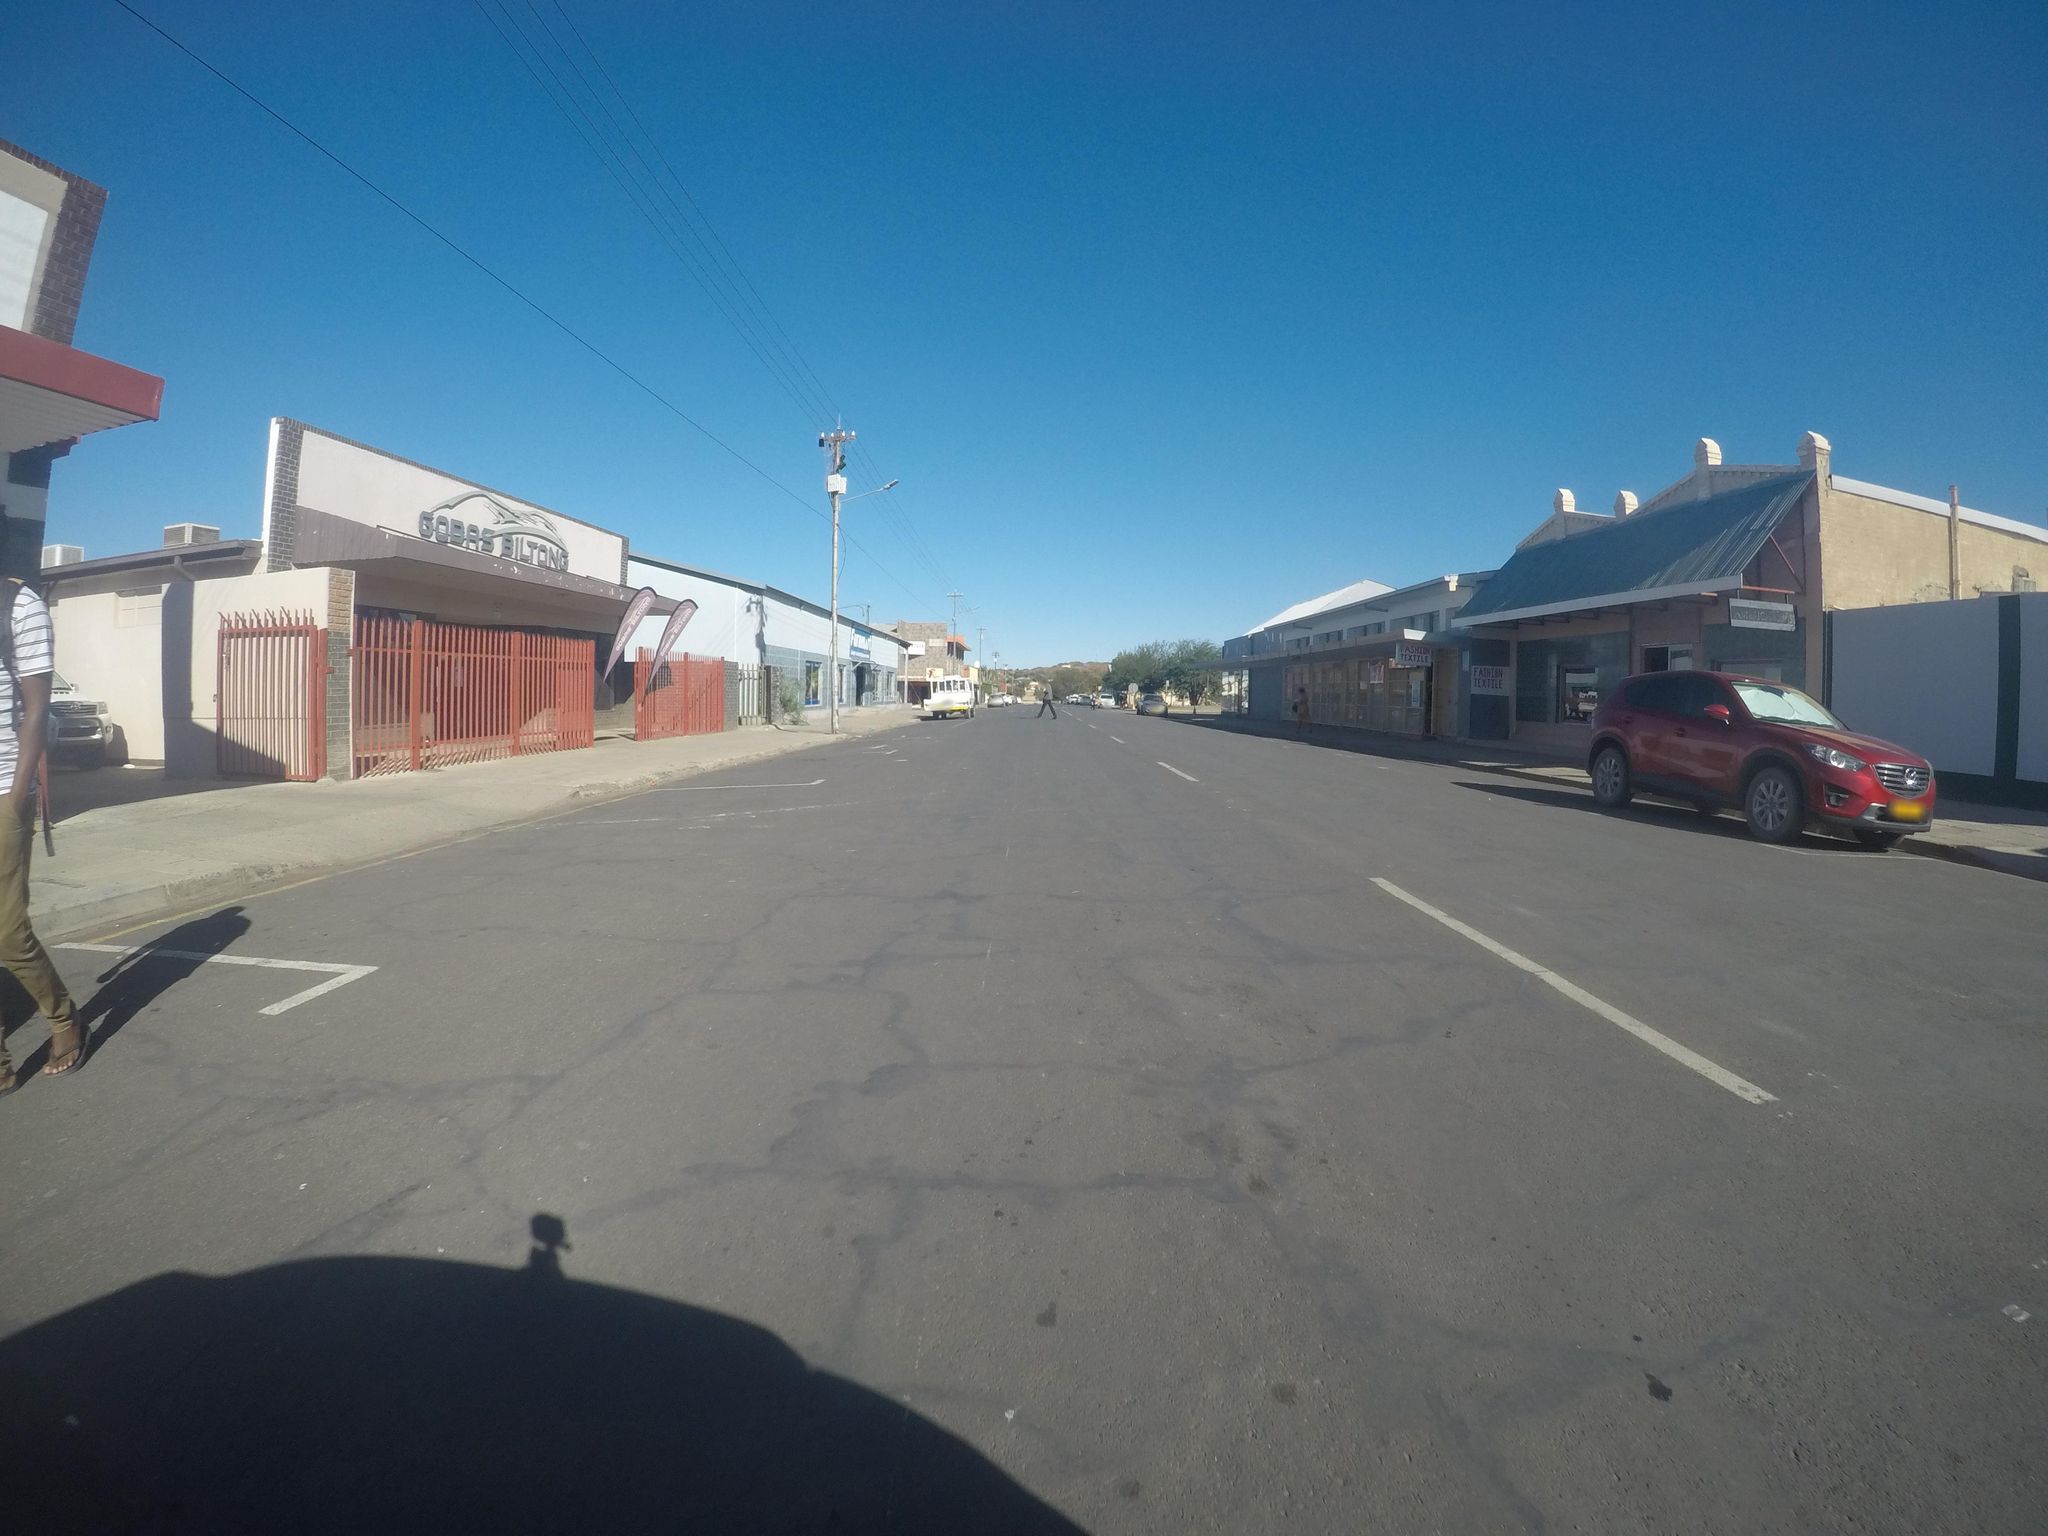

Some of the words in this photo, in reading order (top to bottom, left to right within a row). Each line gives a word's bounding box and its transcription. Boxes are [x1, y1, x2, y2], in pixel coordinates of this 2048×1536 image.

[418, 511, 494, 553] GOBAS
[500, 533, 569, 572] BILTONG
[1400, 646, 1430, 655] FASHION
[1400, 654, 1429, 663] TEXTILE
[1473, 667, 1503, 678] FASHION
[1473, 679, 1503, 689] TEXTILE
